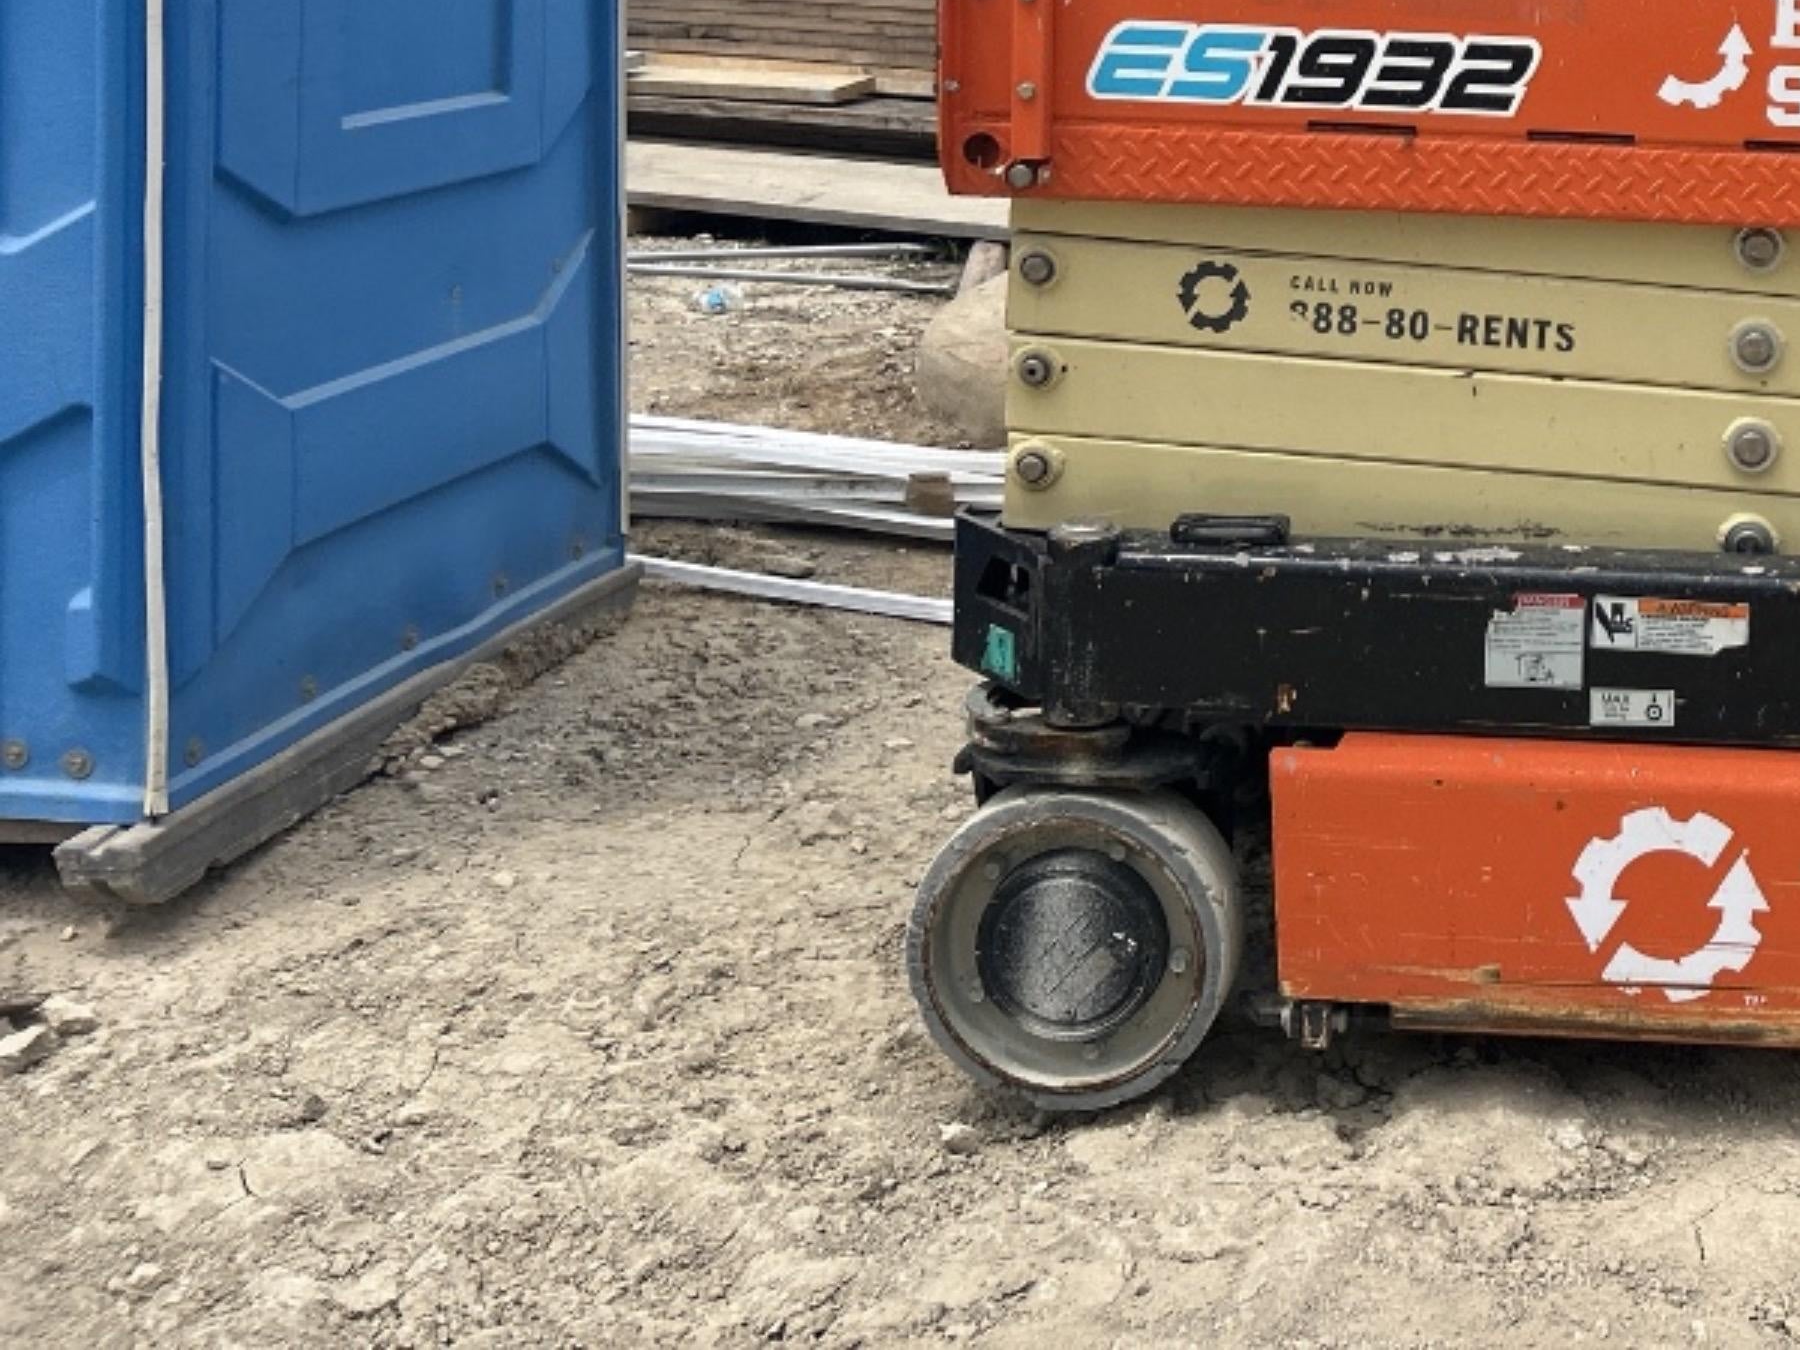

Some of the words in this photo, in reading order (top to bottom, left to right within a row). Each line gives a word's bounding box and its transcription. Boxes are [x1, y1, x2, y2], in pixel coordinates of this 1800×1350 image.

[1088, 22, 1539, 116] ES1932
[1289, 274, 1339, 294] CALL
[1349, 279, 1393, 298] NOW
